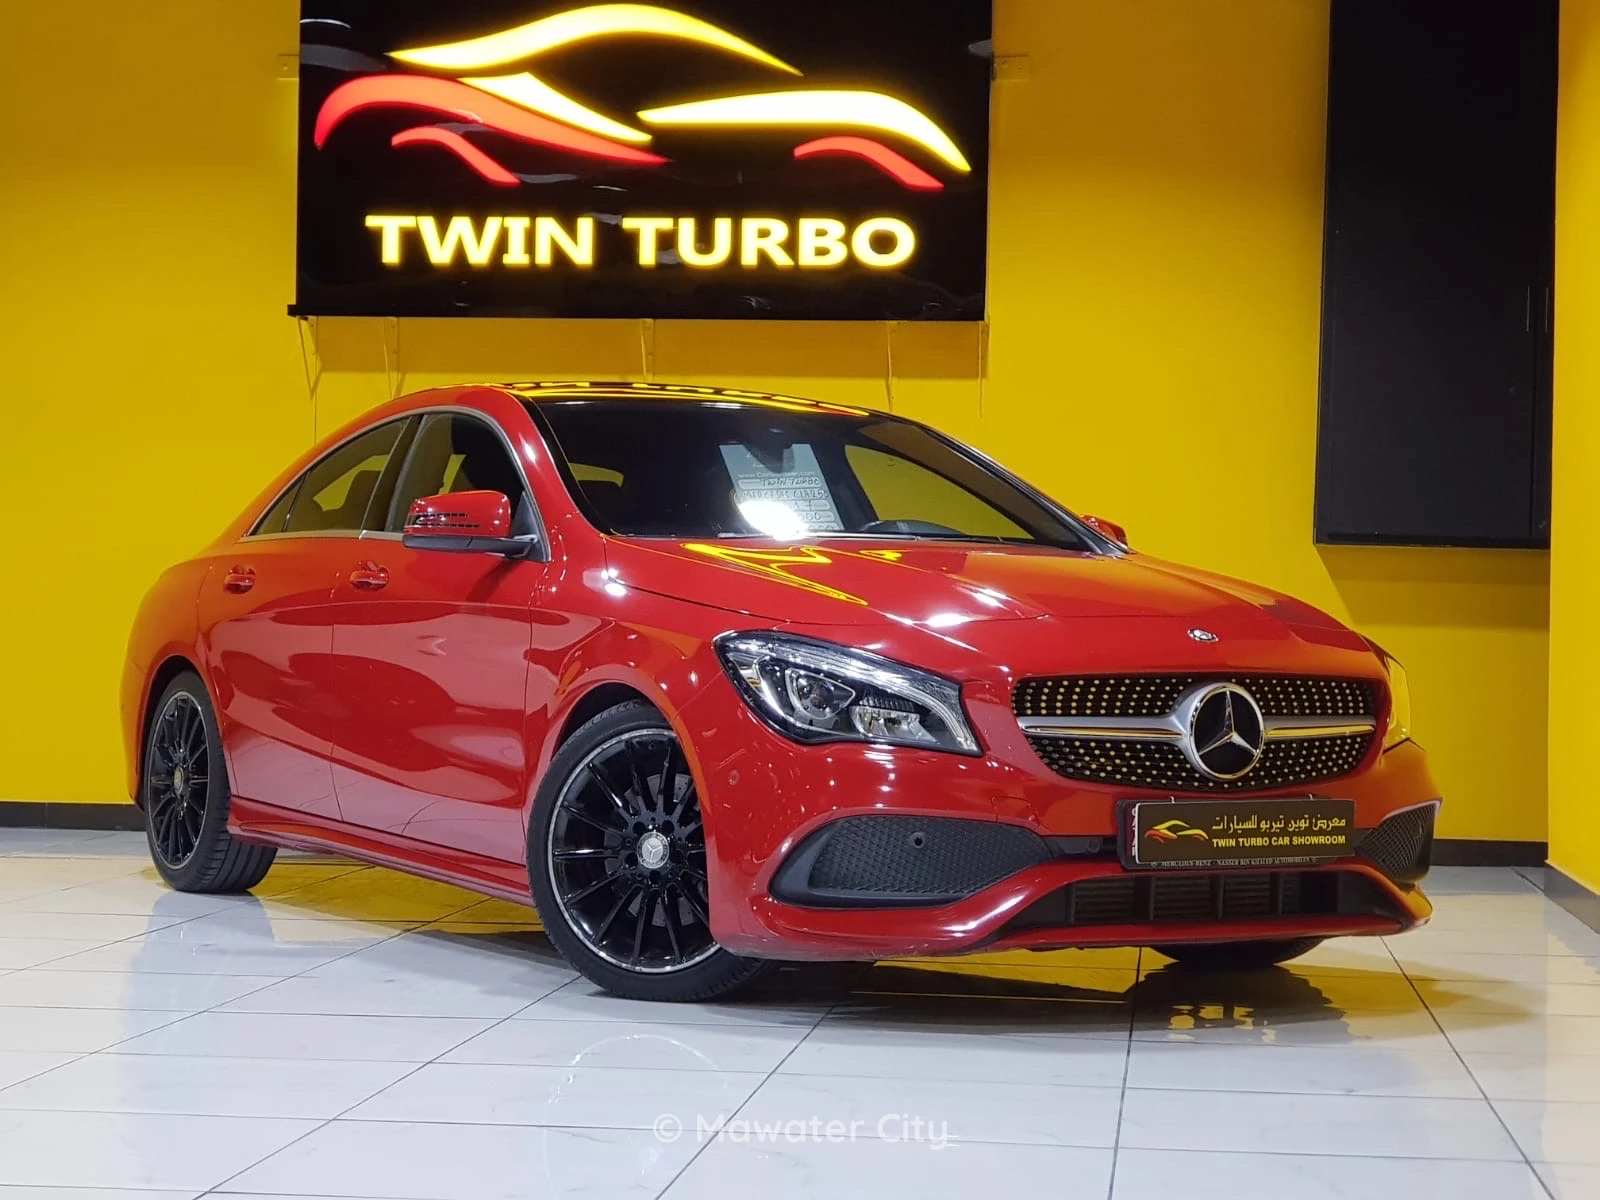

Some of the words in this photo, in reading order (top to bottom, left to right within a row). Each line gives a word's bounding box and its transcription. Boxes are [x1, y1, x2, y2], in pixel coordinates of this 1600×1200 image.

[365, 215, 595, 266] TWIN
[621, 216, 916, 268] TURBO
[1211, 814, 1258, 834] للسيارات
[1260, 815, 1285, 833] تيربو
[1287, 814, 1310, 832] توين
[1312, 814, 1346, 831] معرض
[1211, 838, 1236, 848] TWIN
[1238, 836, 1270, 847] TURBO
[1271, 835, 1290, 846] CAR
[1292, 835, 1346, 845] SHOWROOM
